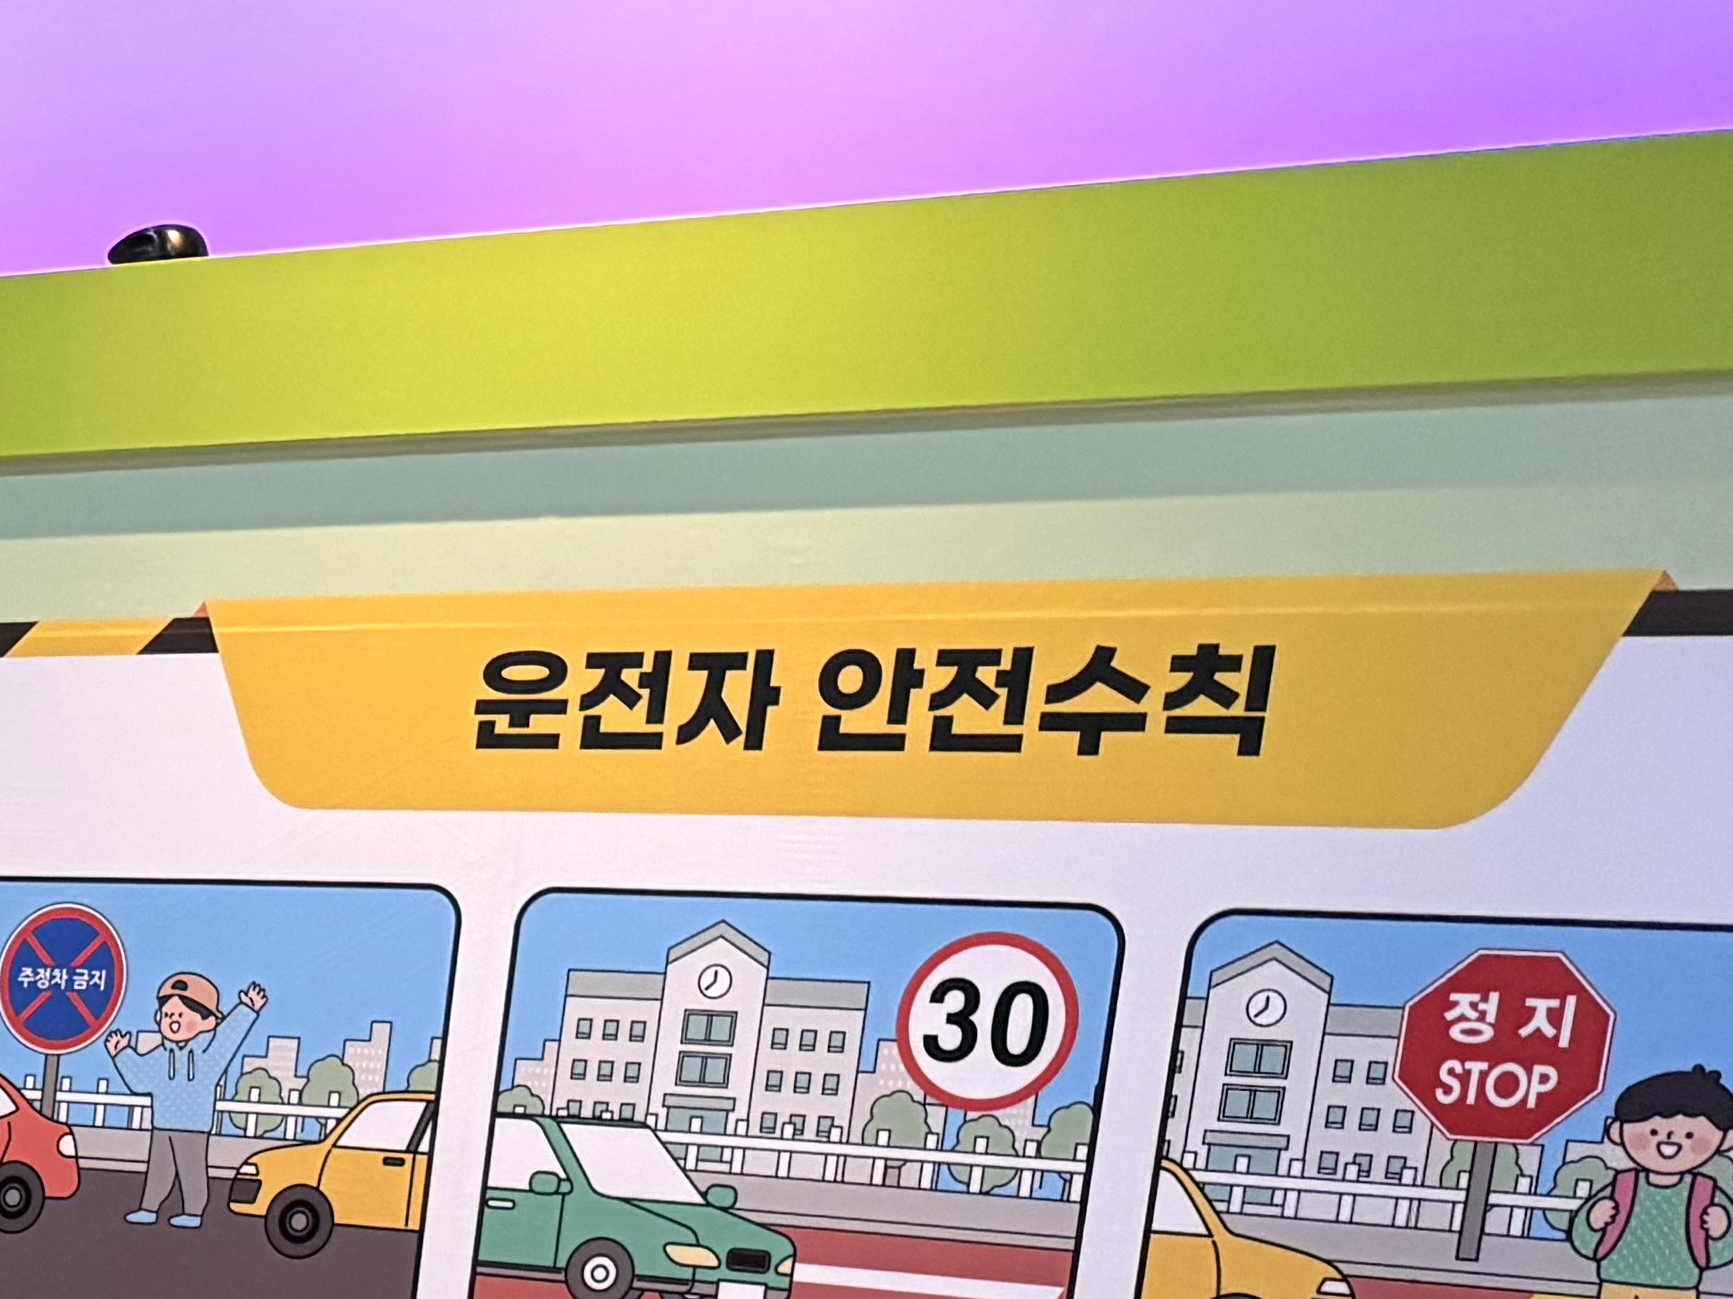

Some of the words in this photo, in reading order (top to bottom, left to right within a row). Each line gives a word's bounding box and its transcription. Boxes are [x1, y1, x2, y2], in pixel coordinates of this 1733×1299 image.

[474, 648, 781, 752] 운전자
[817, 643, 1276, 757] 안전수칙
[18, 967, 69, 990] 주정차
[72, 969, 107, 991] 금지
[922, 977, 1051, 1069] 30
[1434, 1059, 1559, 1112] STOP
